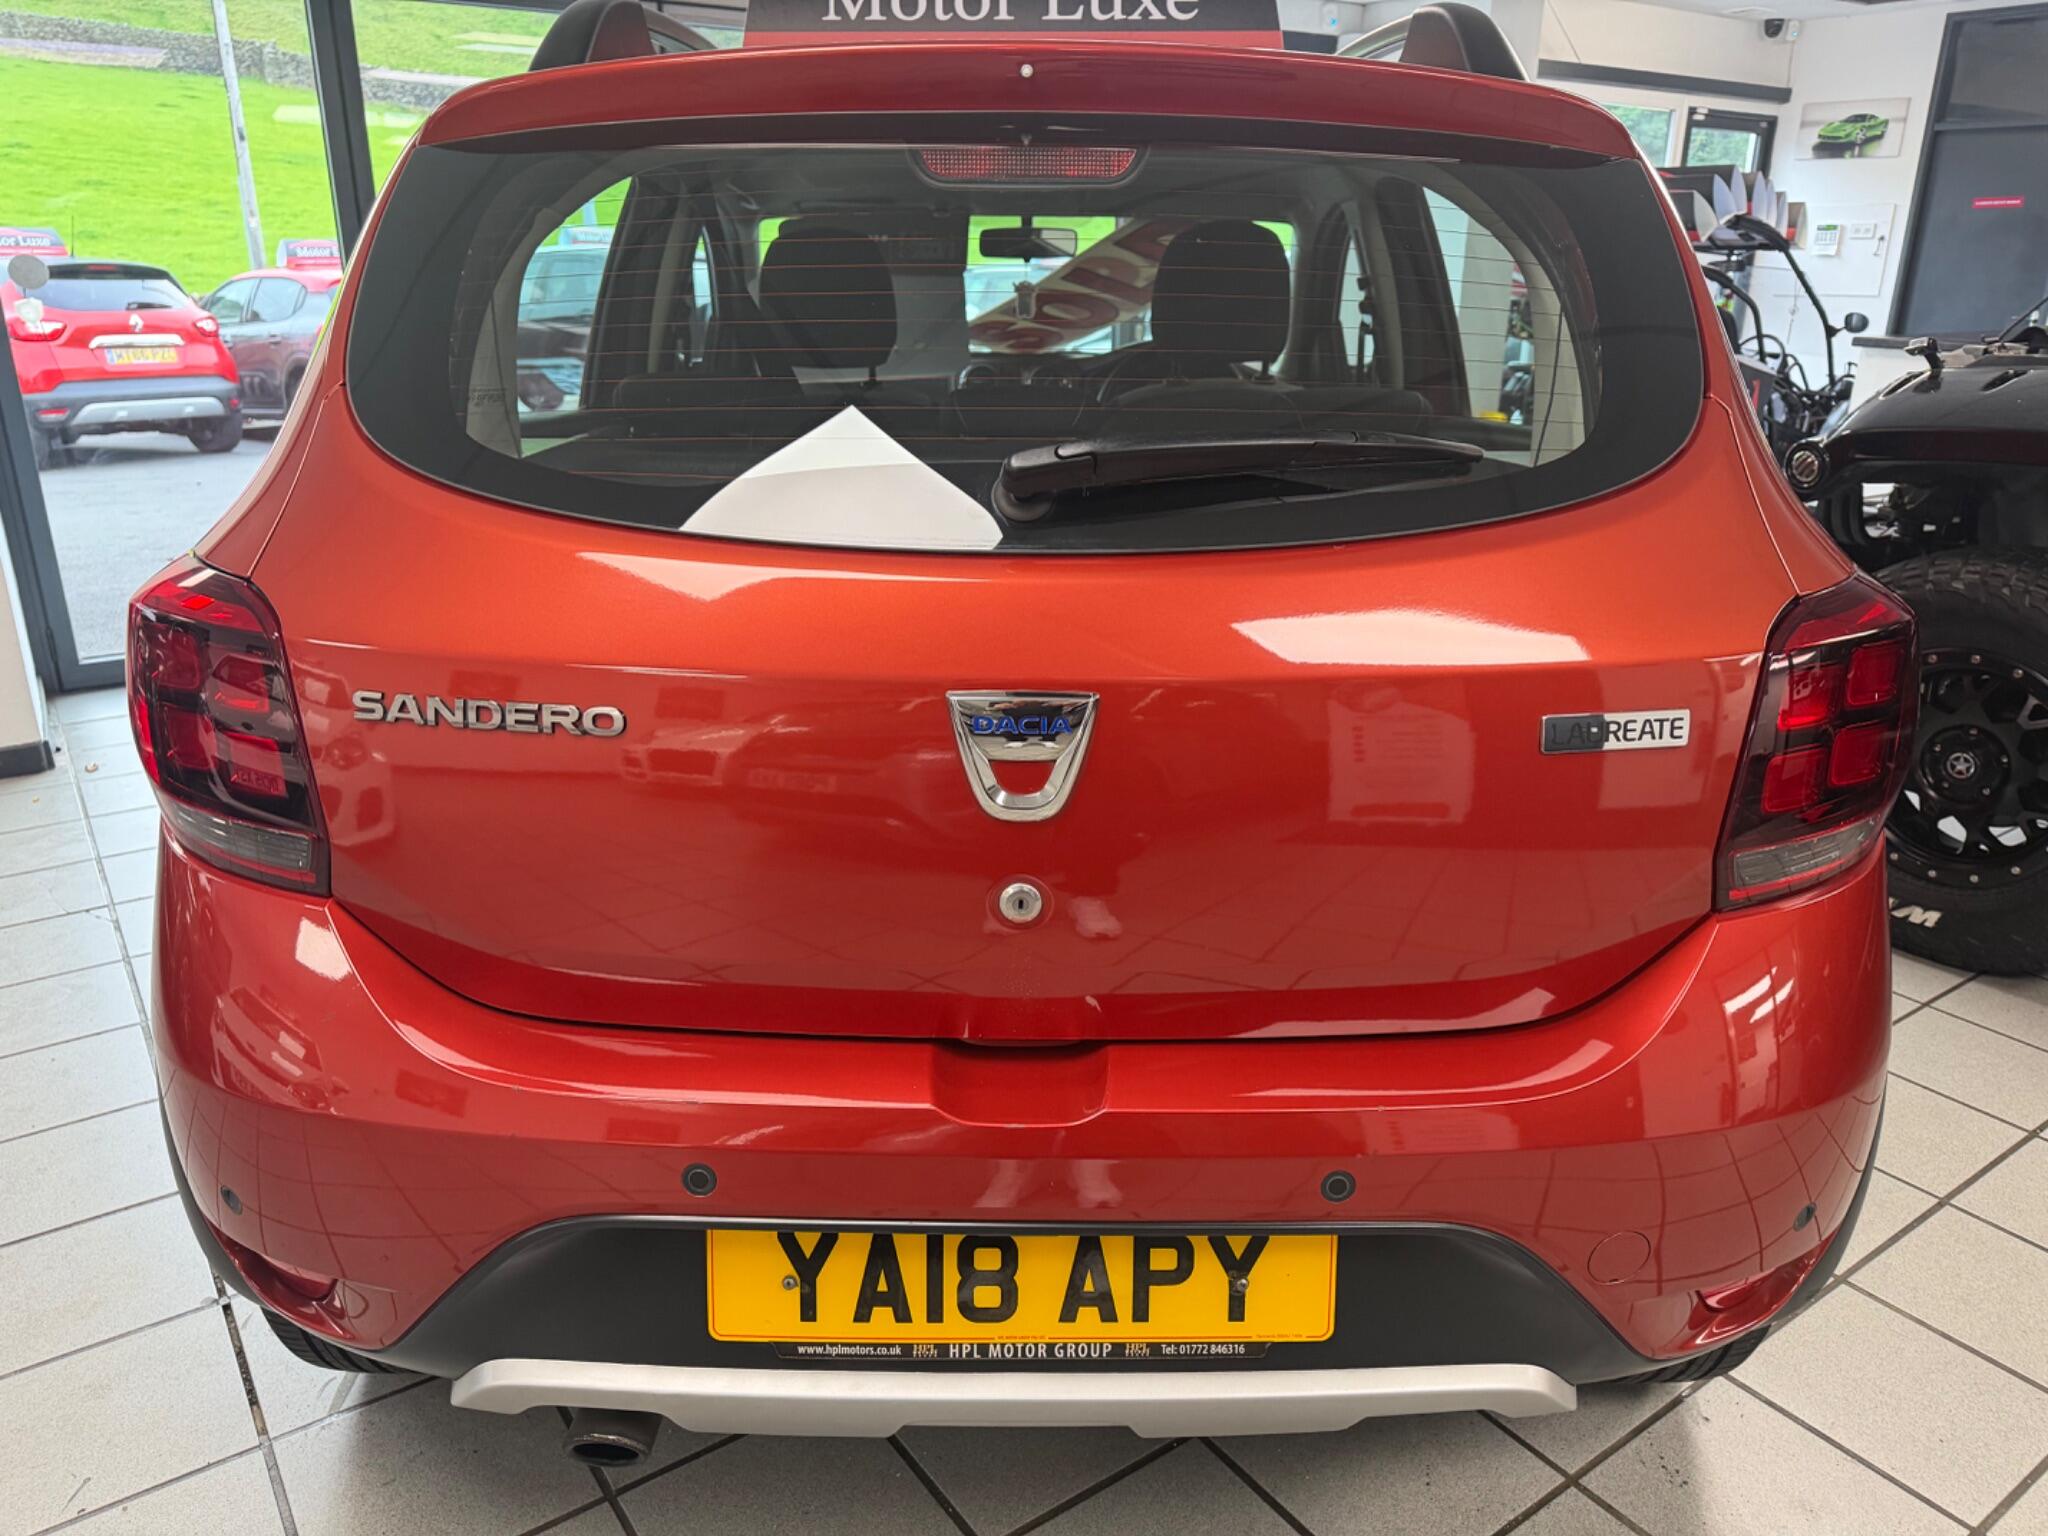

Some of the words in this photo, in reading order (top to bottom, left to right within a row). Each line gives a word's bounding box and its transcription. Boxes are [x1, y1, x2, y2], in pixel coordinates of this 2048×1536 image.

[821, 0, 1014, 21] Motor
[1041, 0, 1200, 21] Luxe
[351, 689, 628, 738] SANDERO
[972, 714, 1073, 735] DACIA
[1551, 716, 1685, 746] LAUREATE
[777, 1232, 1018, 1323] YA18
[1058, 1235, 1270, 1323] APY
[797, 1343, 902, 1357] www.hplmotors.co.uk
[950, 1343, 981, 1358] HPL
[988, 1343, 1047, 1358] MOTOR
[1054, 1343, 1112, 1358] GROUP
[1161, 1343, 1178, 1355] Tel:
[1179, 1343, 1208, 1355] 01772
[1210, 1343, 1245, 1355] 846316
